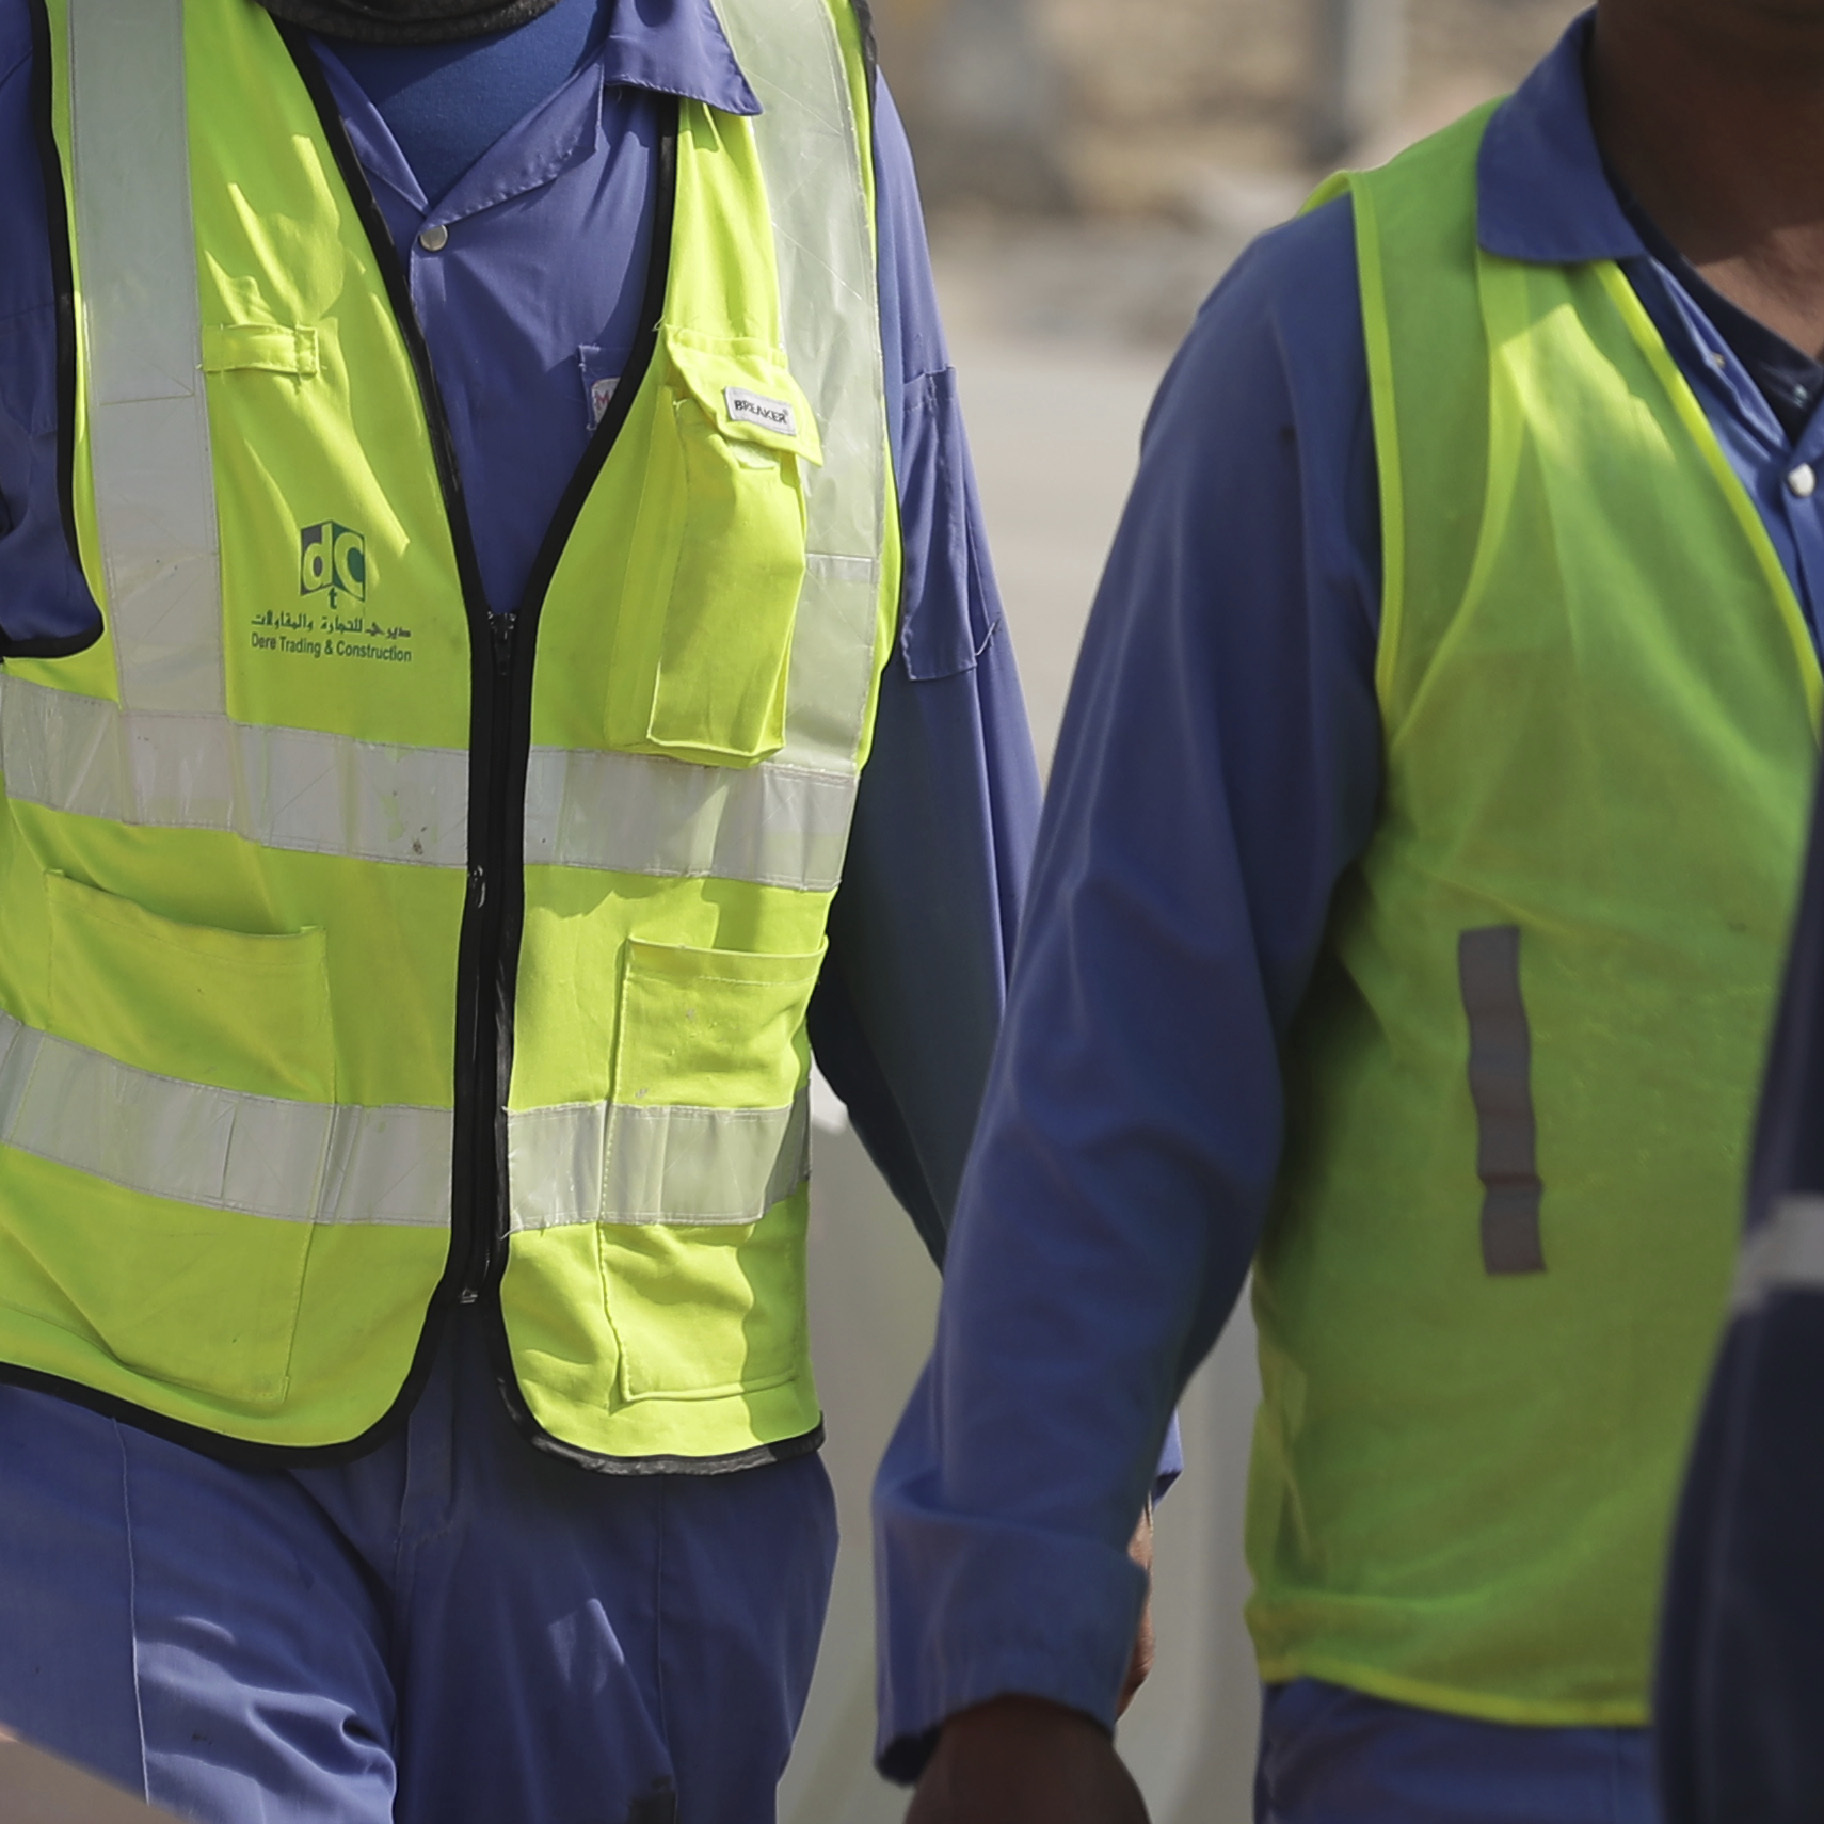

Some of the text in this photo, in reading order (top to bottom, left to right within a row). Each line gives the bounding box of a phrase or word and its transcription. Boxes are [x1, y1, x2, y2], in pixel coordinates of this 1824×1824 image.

[734, 399, 787, 425] BREAKER
[251, 609, 314, 632] والمقاولات
[320, 615, 363, 635] للتجارة
[251, 631, 413, 663] Dere Trading & Construction
